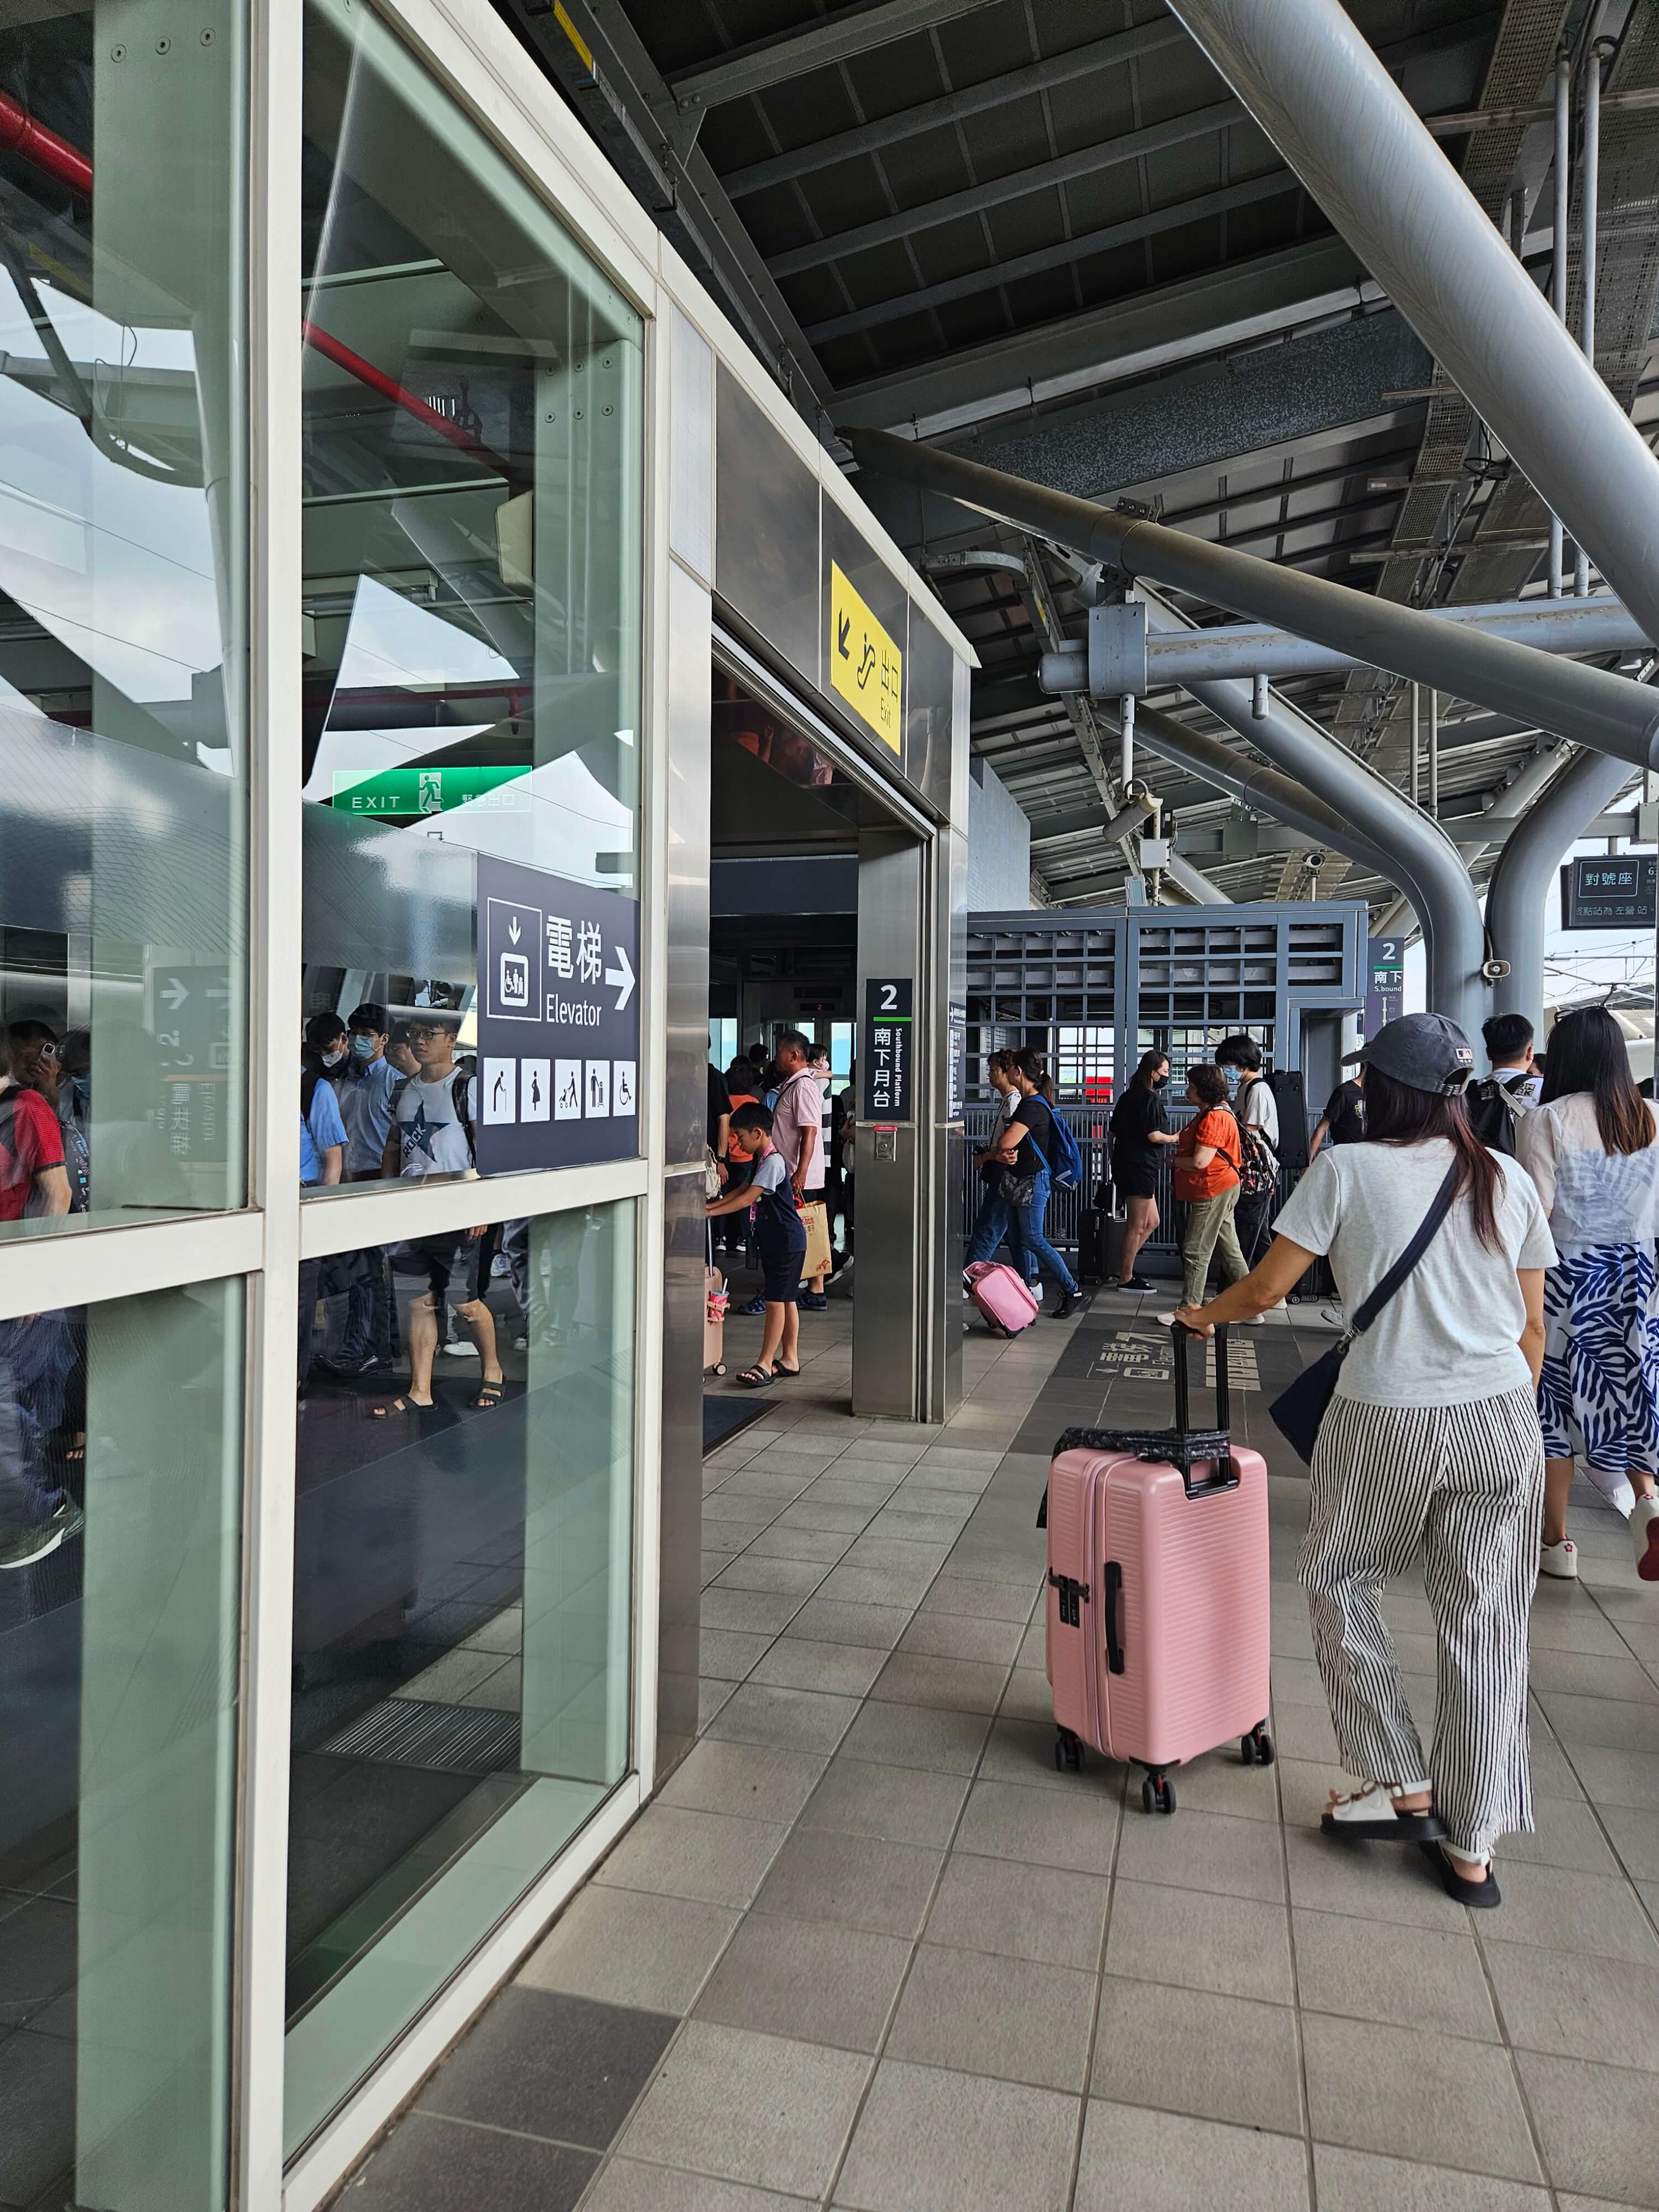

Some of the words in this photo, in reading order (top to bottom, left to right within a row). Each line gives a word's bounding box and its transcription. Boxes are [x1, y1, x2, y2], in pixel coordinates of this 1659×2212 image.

[881, 649, 898, 702] 出口
[880, 697, 891, 729] Exit
[352, 796, 400, 808] EXIT
[1585, 872, 1632, 885] 對號座
[546, 915, 602, 984] 電梯
[1383, 942, 1396, 960] 2
[1374, 971, 1402, 984] 南下
[546, 993, 602, 1026] Elevator
[880, 984, 898, 1010] 2
[873, 1028, 891, 1107] 南下月台
[403, 1124, 426, 1158] ROCK
